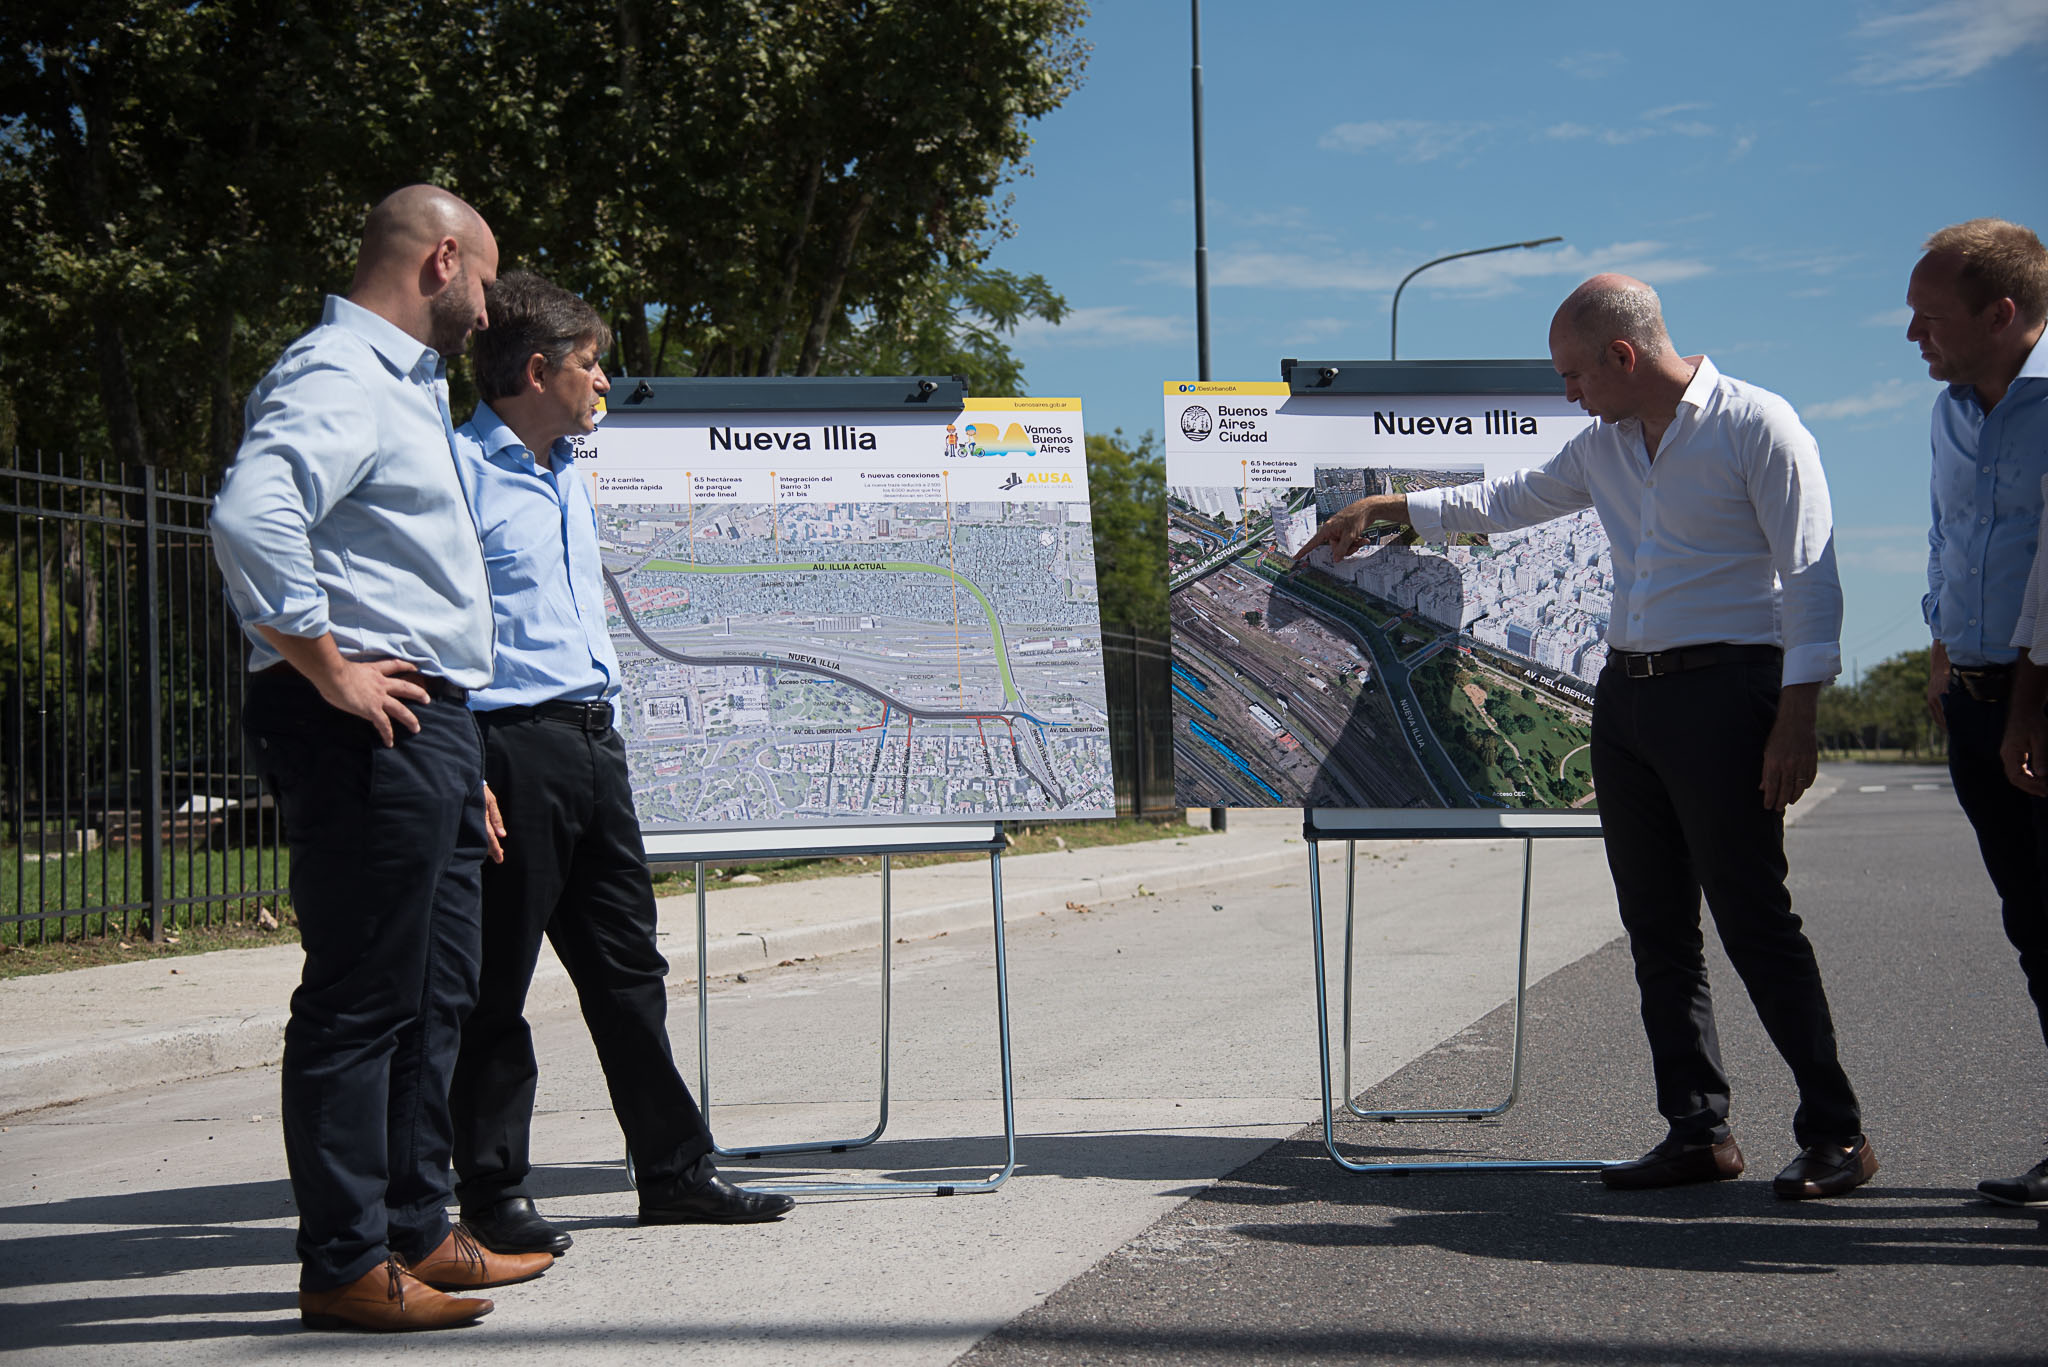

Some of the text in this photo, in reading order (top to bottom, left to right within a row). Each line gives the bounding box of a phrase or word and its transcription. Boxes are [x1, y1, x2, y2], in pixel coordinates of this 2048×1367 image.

[1218, 406, 1268, 416] Buenos
[1024, 424, 1062, 434] Vamos
[1218, 418, 1256, 430] Aires
[1373, 410, 1538, 435] Nueva Illia
[709, 425, 877, 450] Nueva Illia
[1032, 434, 1074, 444] Buenos
[1218, 431, 1268, 442] Ciudad
[1040, 444, 1070, 454] Aires
[1026, 472, 1072, 483] AUSA
[1178, 544, 1242, 582] AU. ILLIA ACTUAL
[788, 652, 840, 671] NUEVA ILLIA
[1524, 669, 1538, 681] AV.
[1539, 675, 1555, 688] DEL
[1400, 699, 1425, 749] NUEVA ILLIA
[1045, 762, 1057, 785] CARLOS
